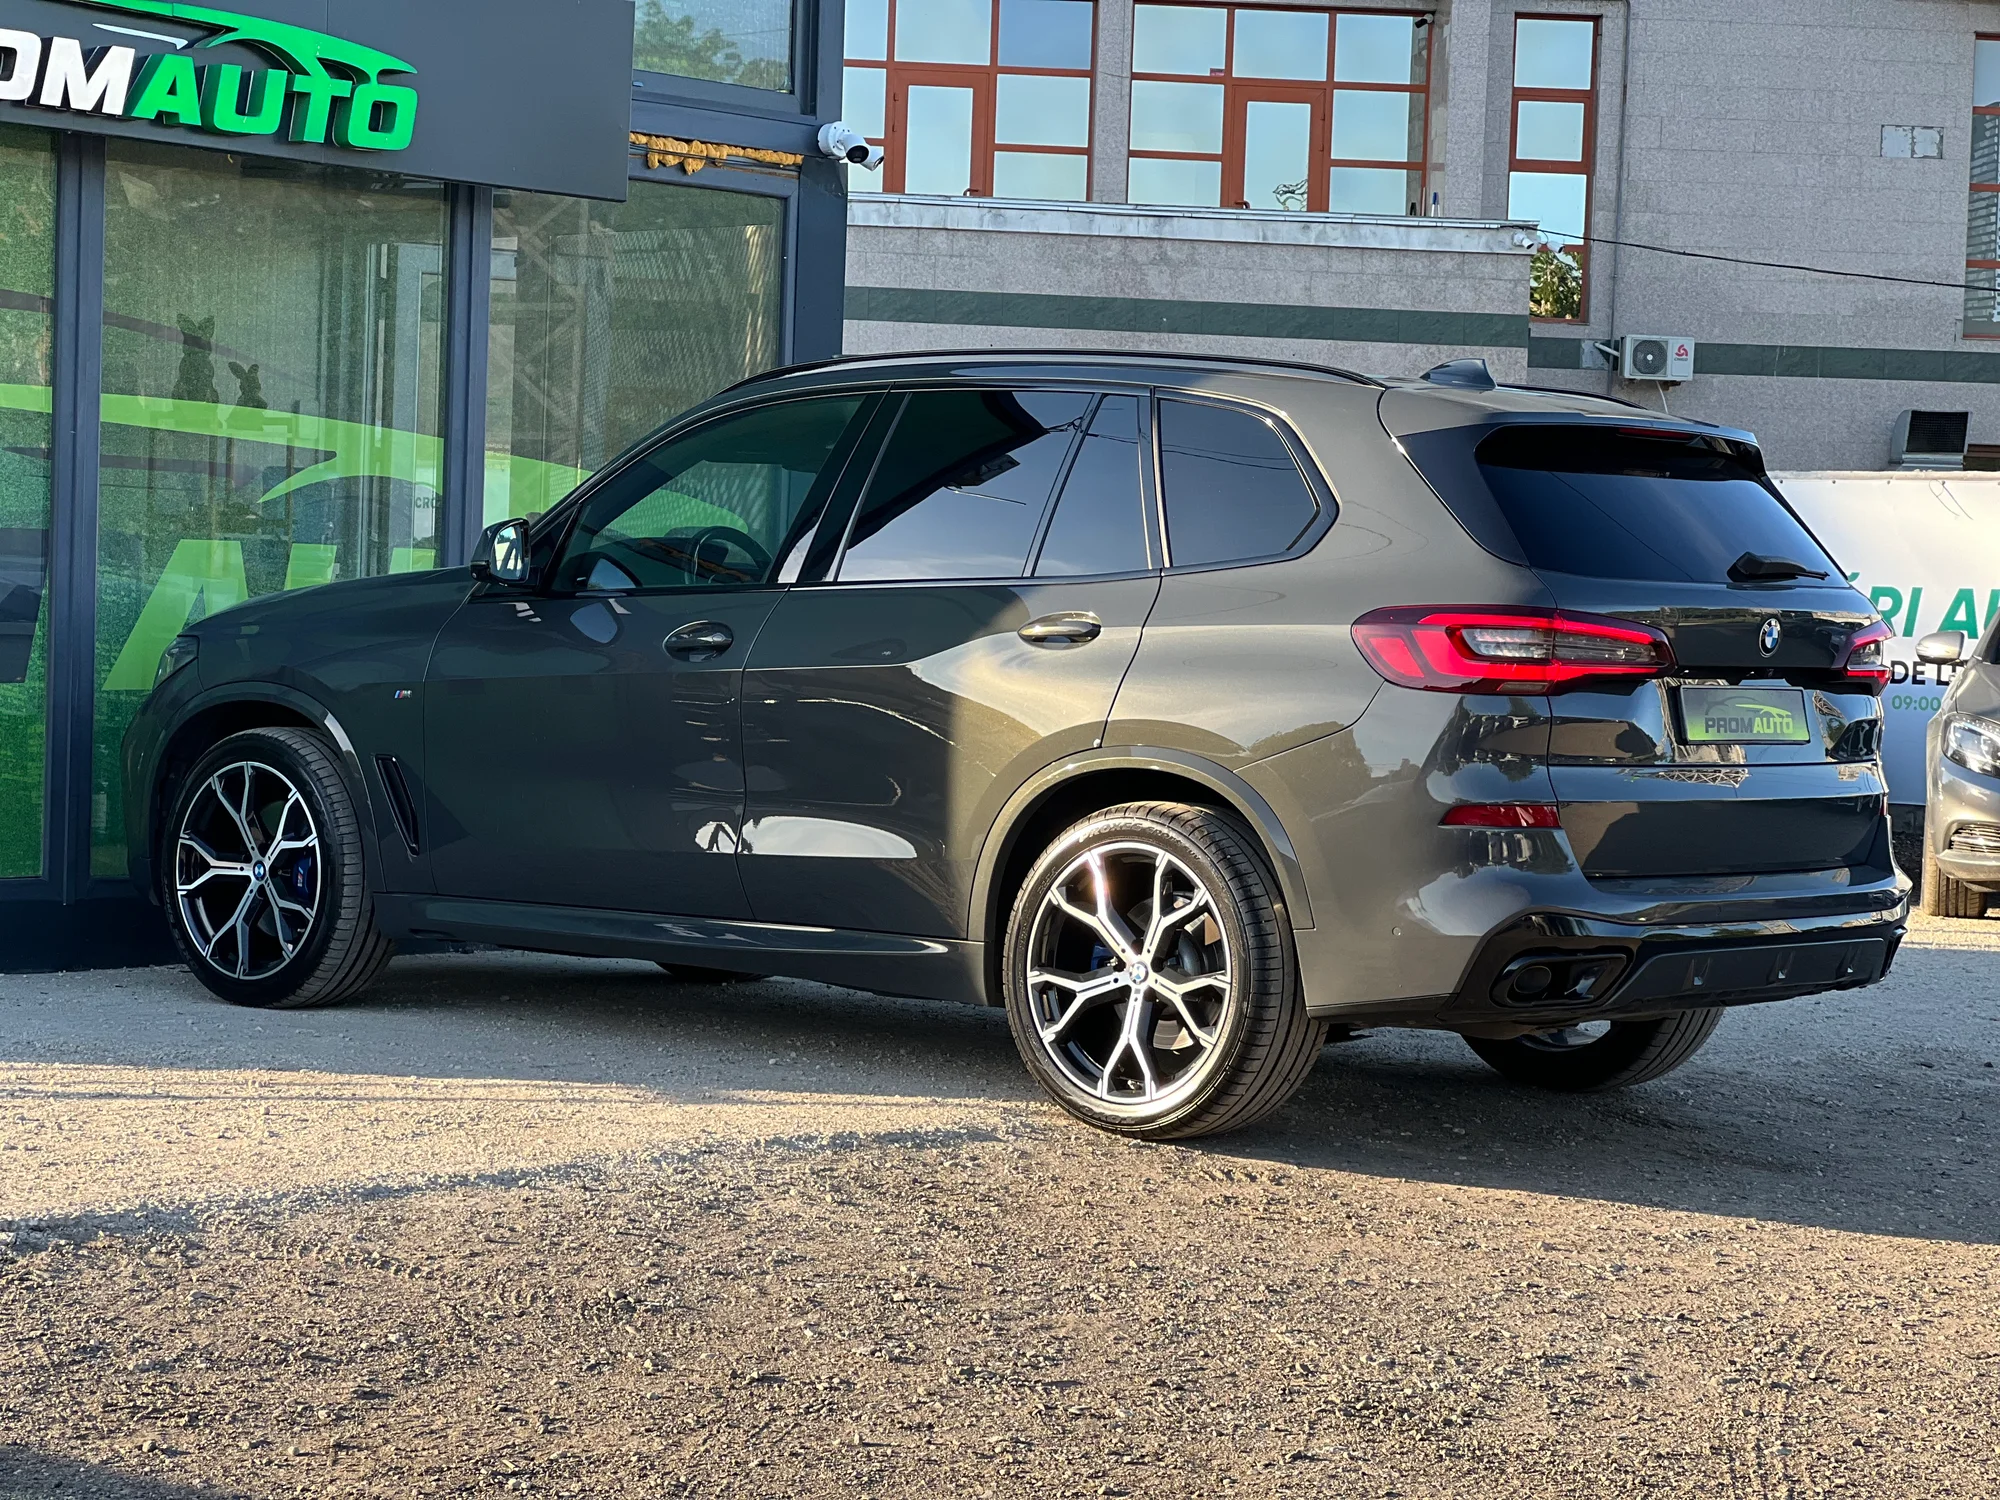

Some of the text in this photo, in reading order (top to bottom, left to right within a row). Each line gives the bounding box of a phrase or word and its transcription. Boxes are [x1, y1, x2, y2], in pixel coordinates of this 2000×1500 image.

[1890, 660, 1926, 685] DE
[1891, 695, 1942, 711] 09:00
[1705, 717, 1794, 734] PROMAUTO
